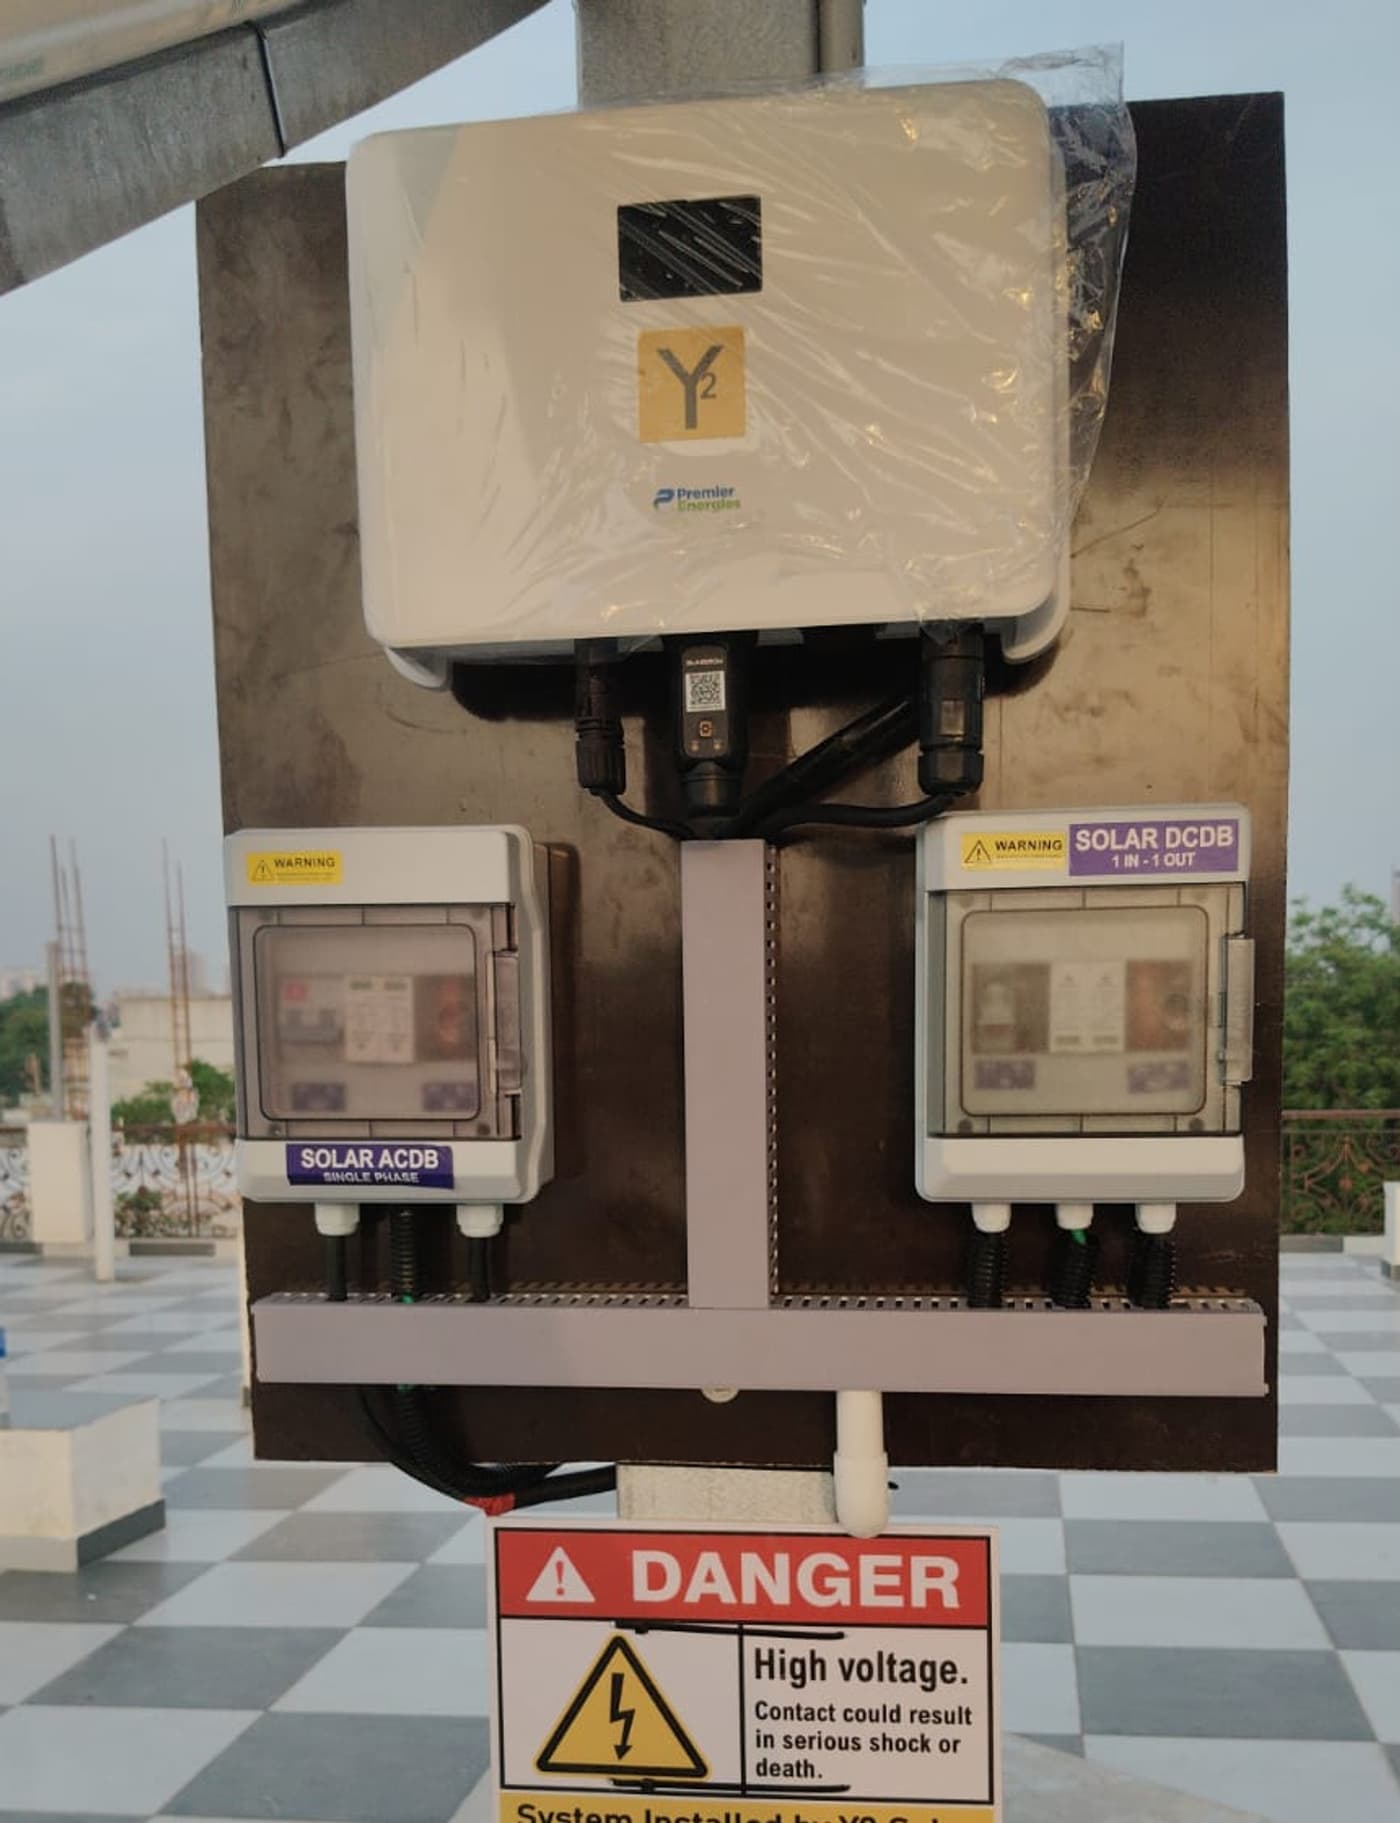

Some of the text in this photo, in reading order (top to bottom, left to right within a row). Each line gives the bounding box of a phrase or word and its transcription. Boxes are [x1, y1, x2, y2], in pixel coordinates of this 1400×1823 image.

[677, 485, 736, 499] Premier
[677, 499, 741, 513] Energies
[994, 839, 1063, 852] WARNING
[1075, 826, 1234, 852] SOLAR DCDB
[273, 857, 336, 868] WARNING
[1111, 855, 1119, 868] 1
[1124, 854, 1139, 868] IN
[1153, 854, 1160, 867] 1
[1164, 852, 1196, 867] OUT
[301, 1148, 440, 1170] SOLAR ACDB
[323, 1171, 420, 1184] SINGLE PHASE
[631, 1549, 961, 1609] DANGER
[754, 1648, 968, 1692] High voltage.
[755, 1700, 972, 1725] Contact could result
[756, 1729, 961, 1753] in serious shock or
[756, 1758, 823, 1779] death.
